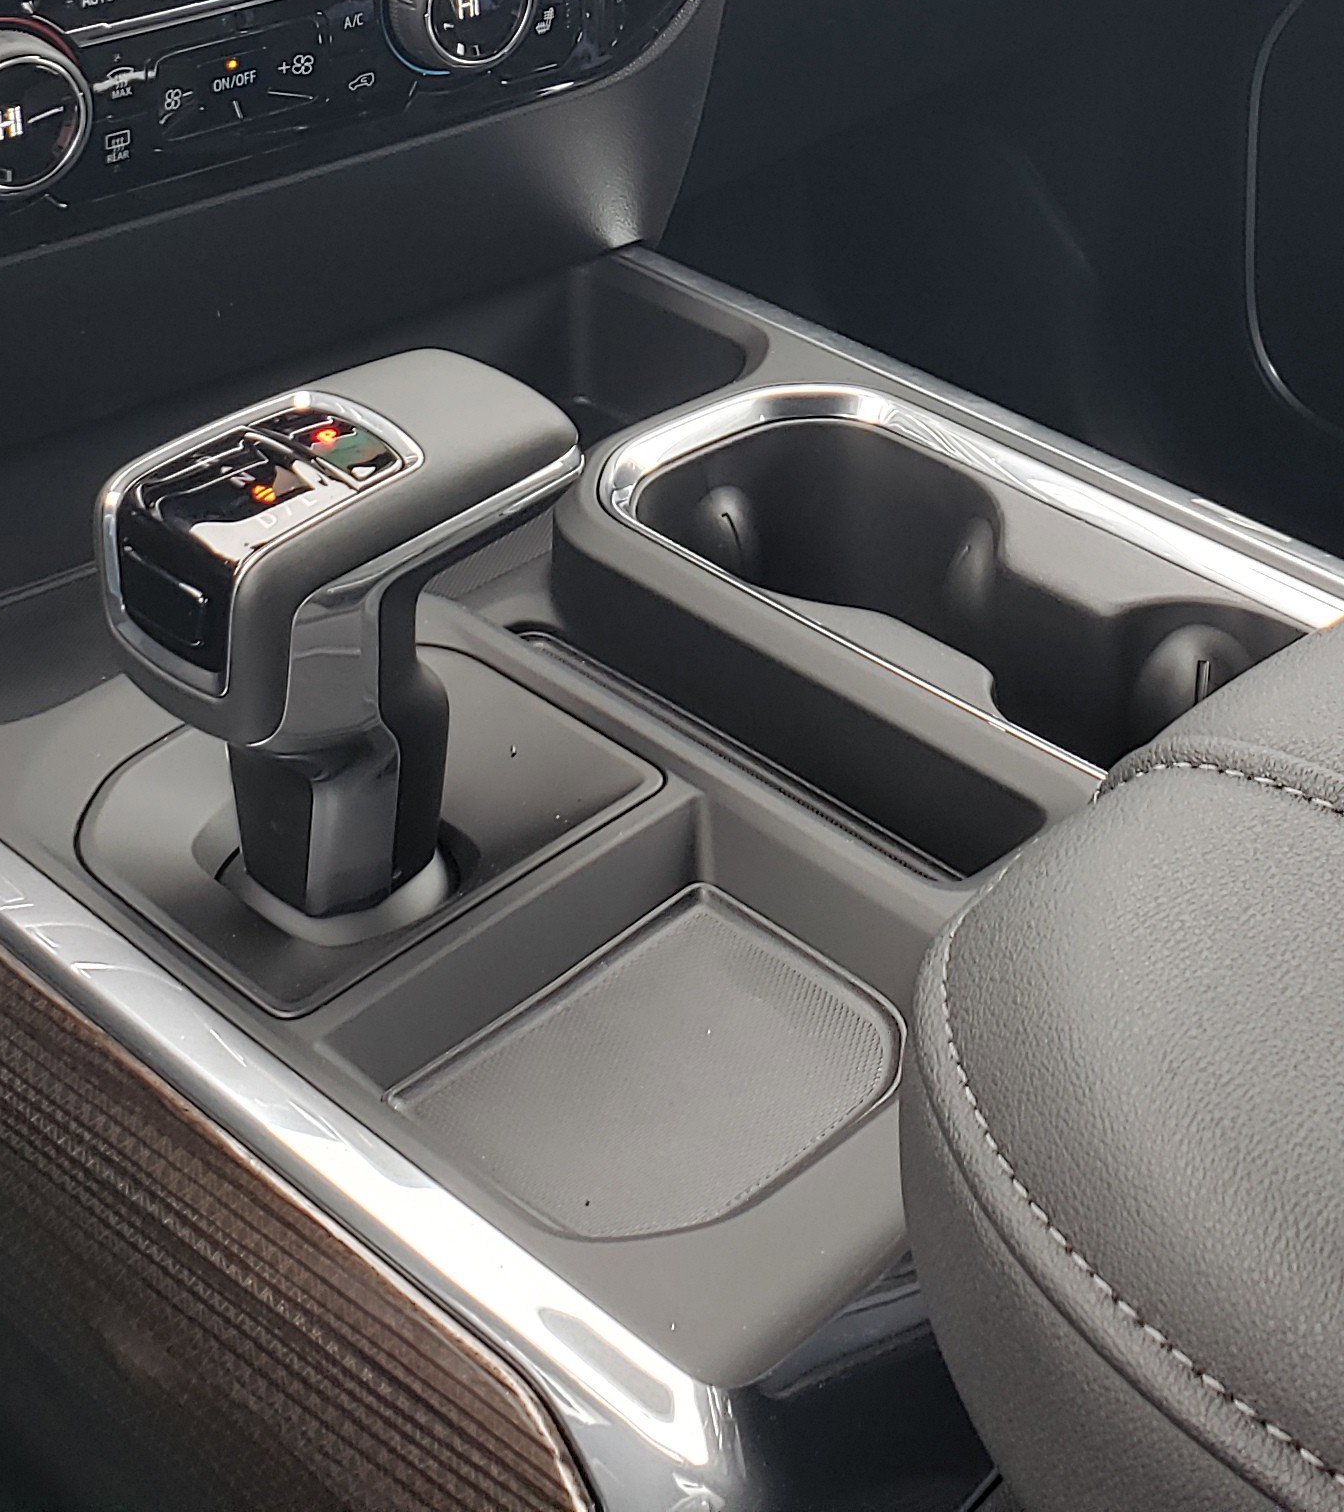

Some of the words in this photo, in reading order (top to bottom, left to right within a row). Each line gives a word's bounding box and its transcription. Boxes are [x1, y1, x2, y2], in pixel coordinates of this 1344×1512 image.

[344, 13, 364, 30] A/C
[213, 69, 257, 93] ON/OFF
[111, 87, 132, 99] MAX
[106, 151, 130, 163] REAR
